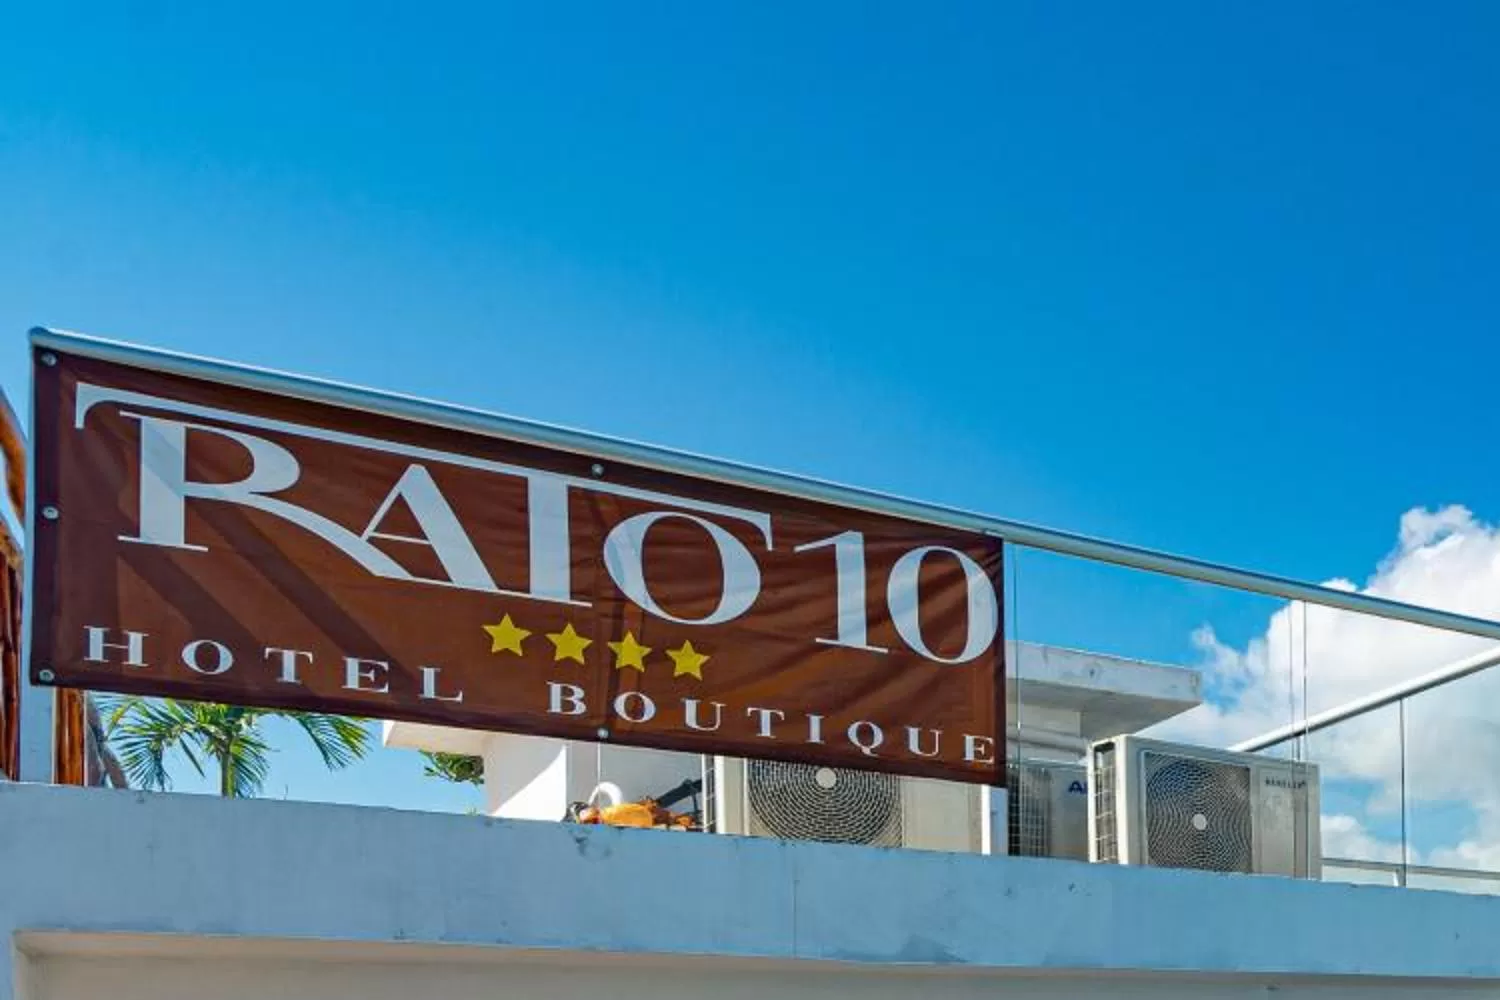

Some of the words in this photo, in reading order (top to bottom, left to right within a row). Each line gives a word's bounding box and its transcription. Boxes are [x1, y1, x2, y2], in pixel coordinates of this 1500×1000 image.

[75, 382, 773, 626] RATO
[795, 530, 999, 665] 10
[83, 625, 464, 703] HOTEL
[546, 680, 996, 765] BOUTIQUE
